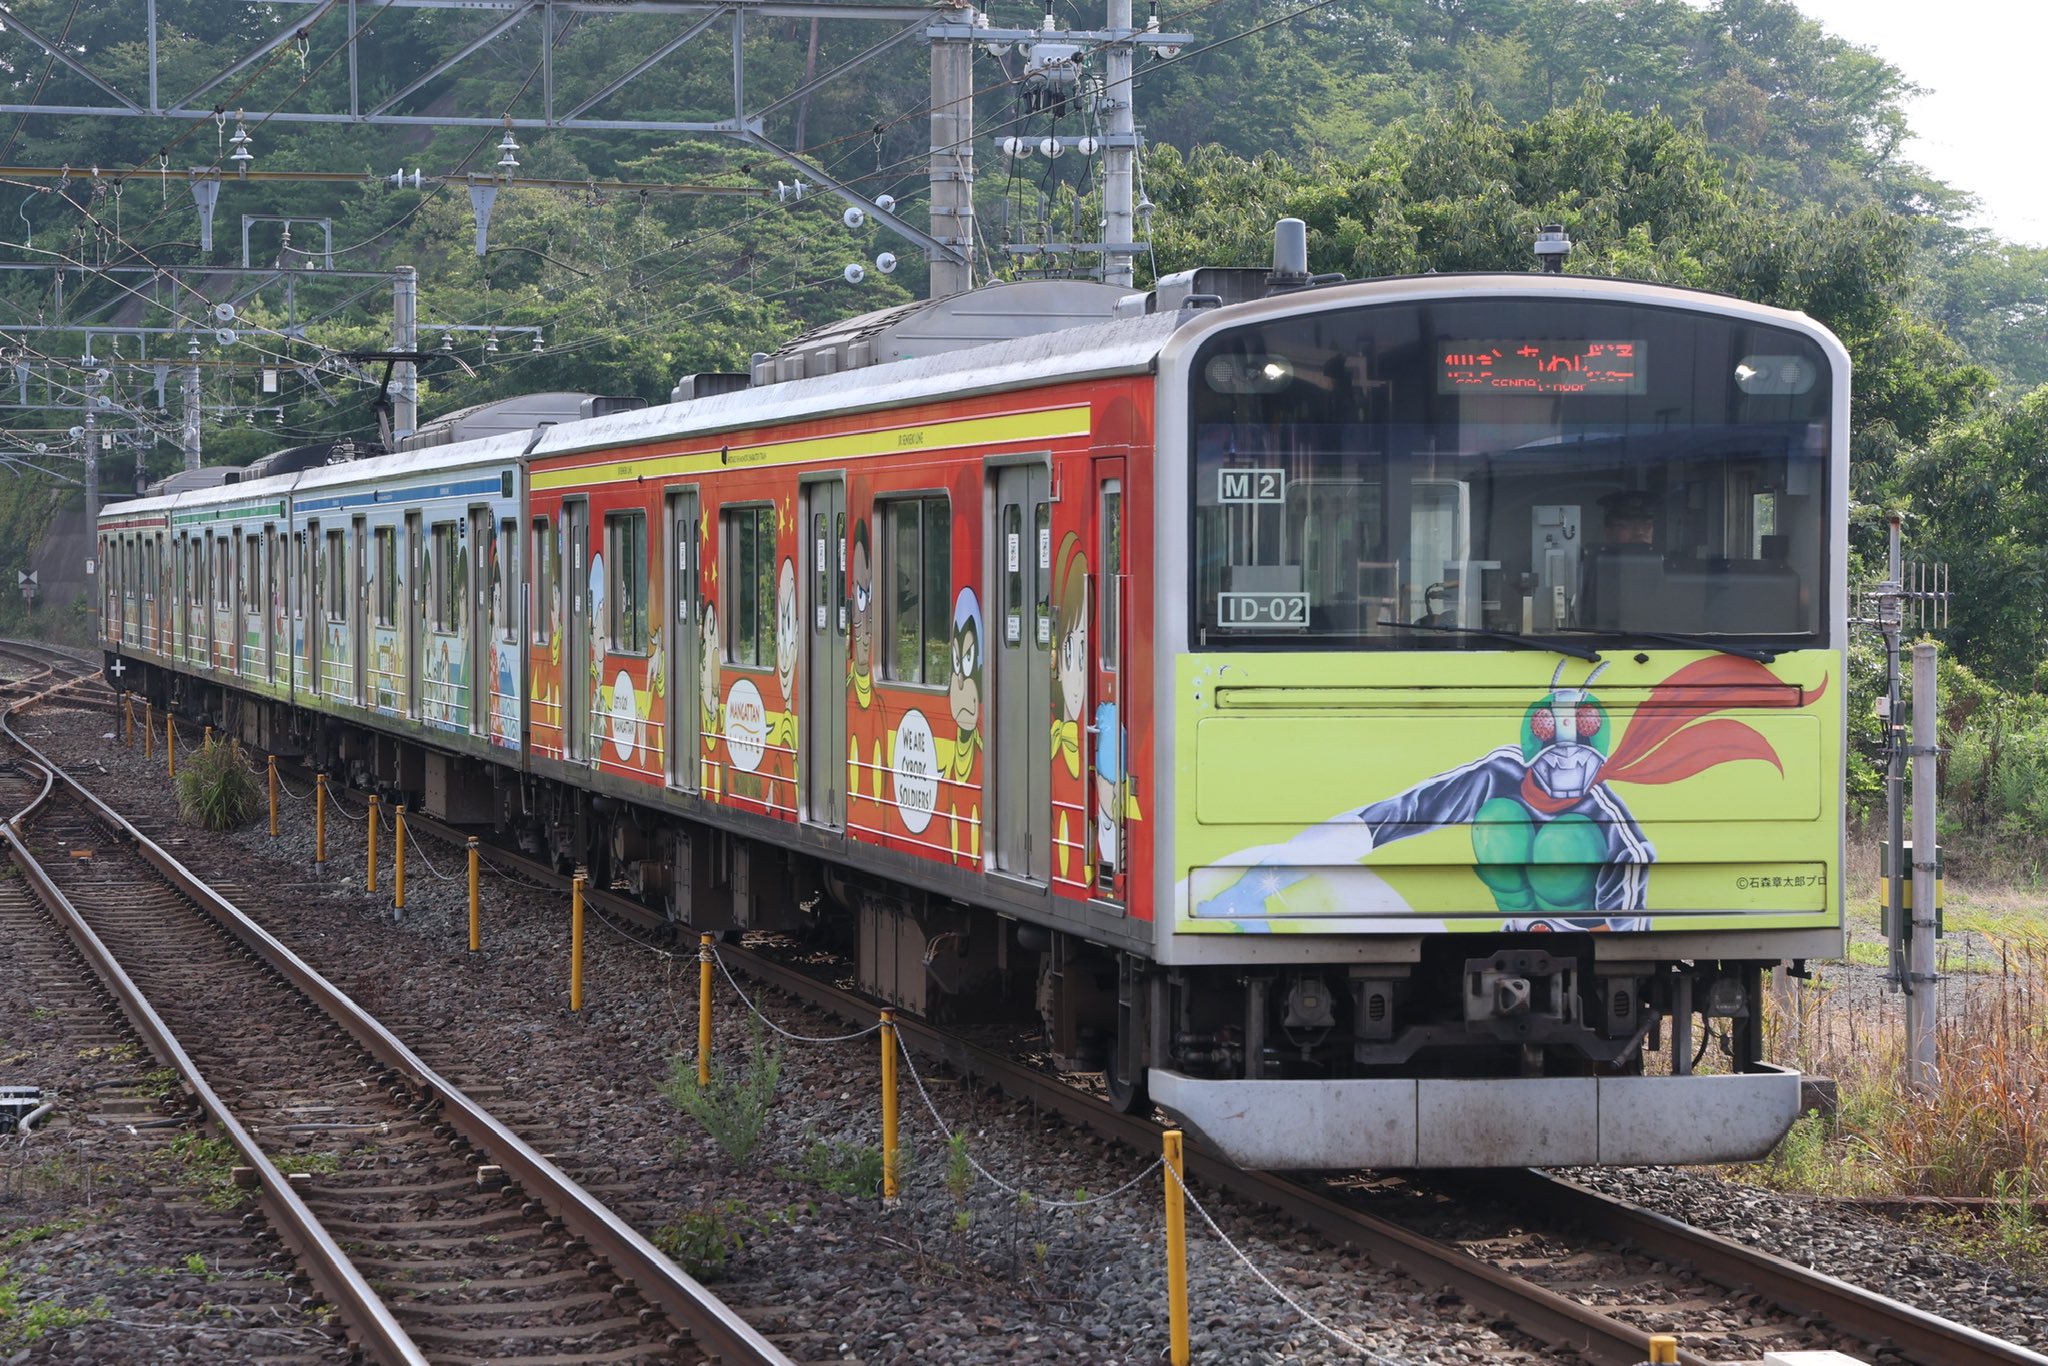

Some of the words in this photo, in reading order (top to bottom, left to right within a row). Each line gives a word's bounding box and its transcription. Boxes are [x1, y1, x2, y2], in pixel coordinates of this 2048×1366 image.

[1229, 597, 1304, 621] ID-02
[902, 727, 912, 751] WE
[913, 731, 925, 753] ARE
[899, 784, 932, 811] SOLDIERS!
